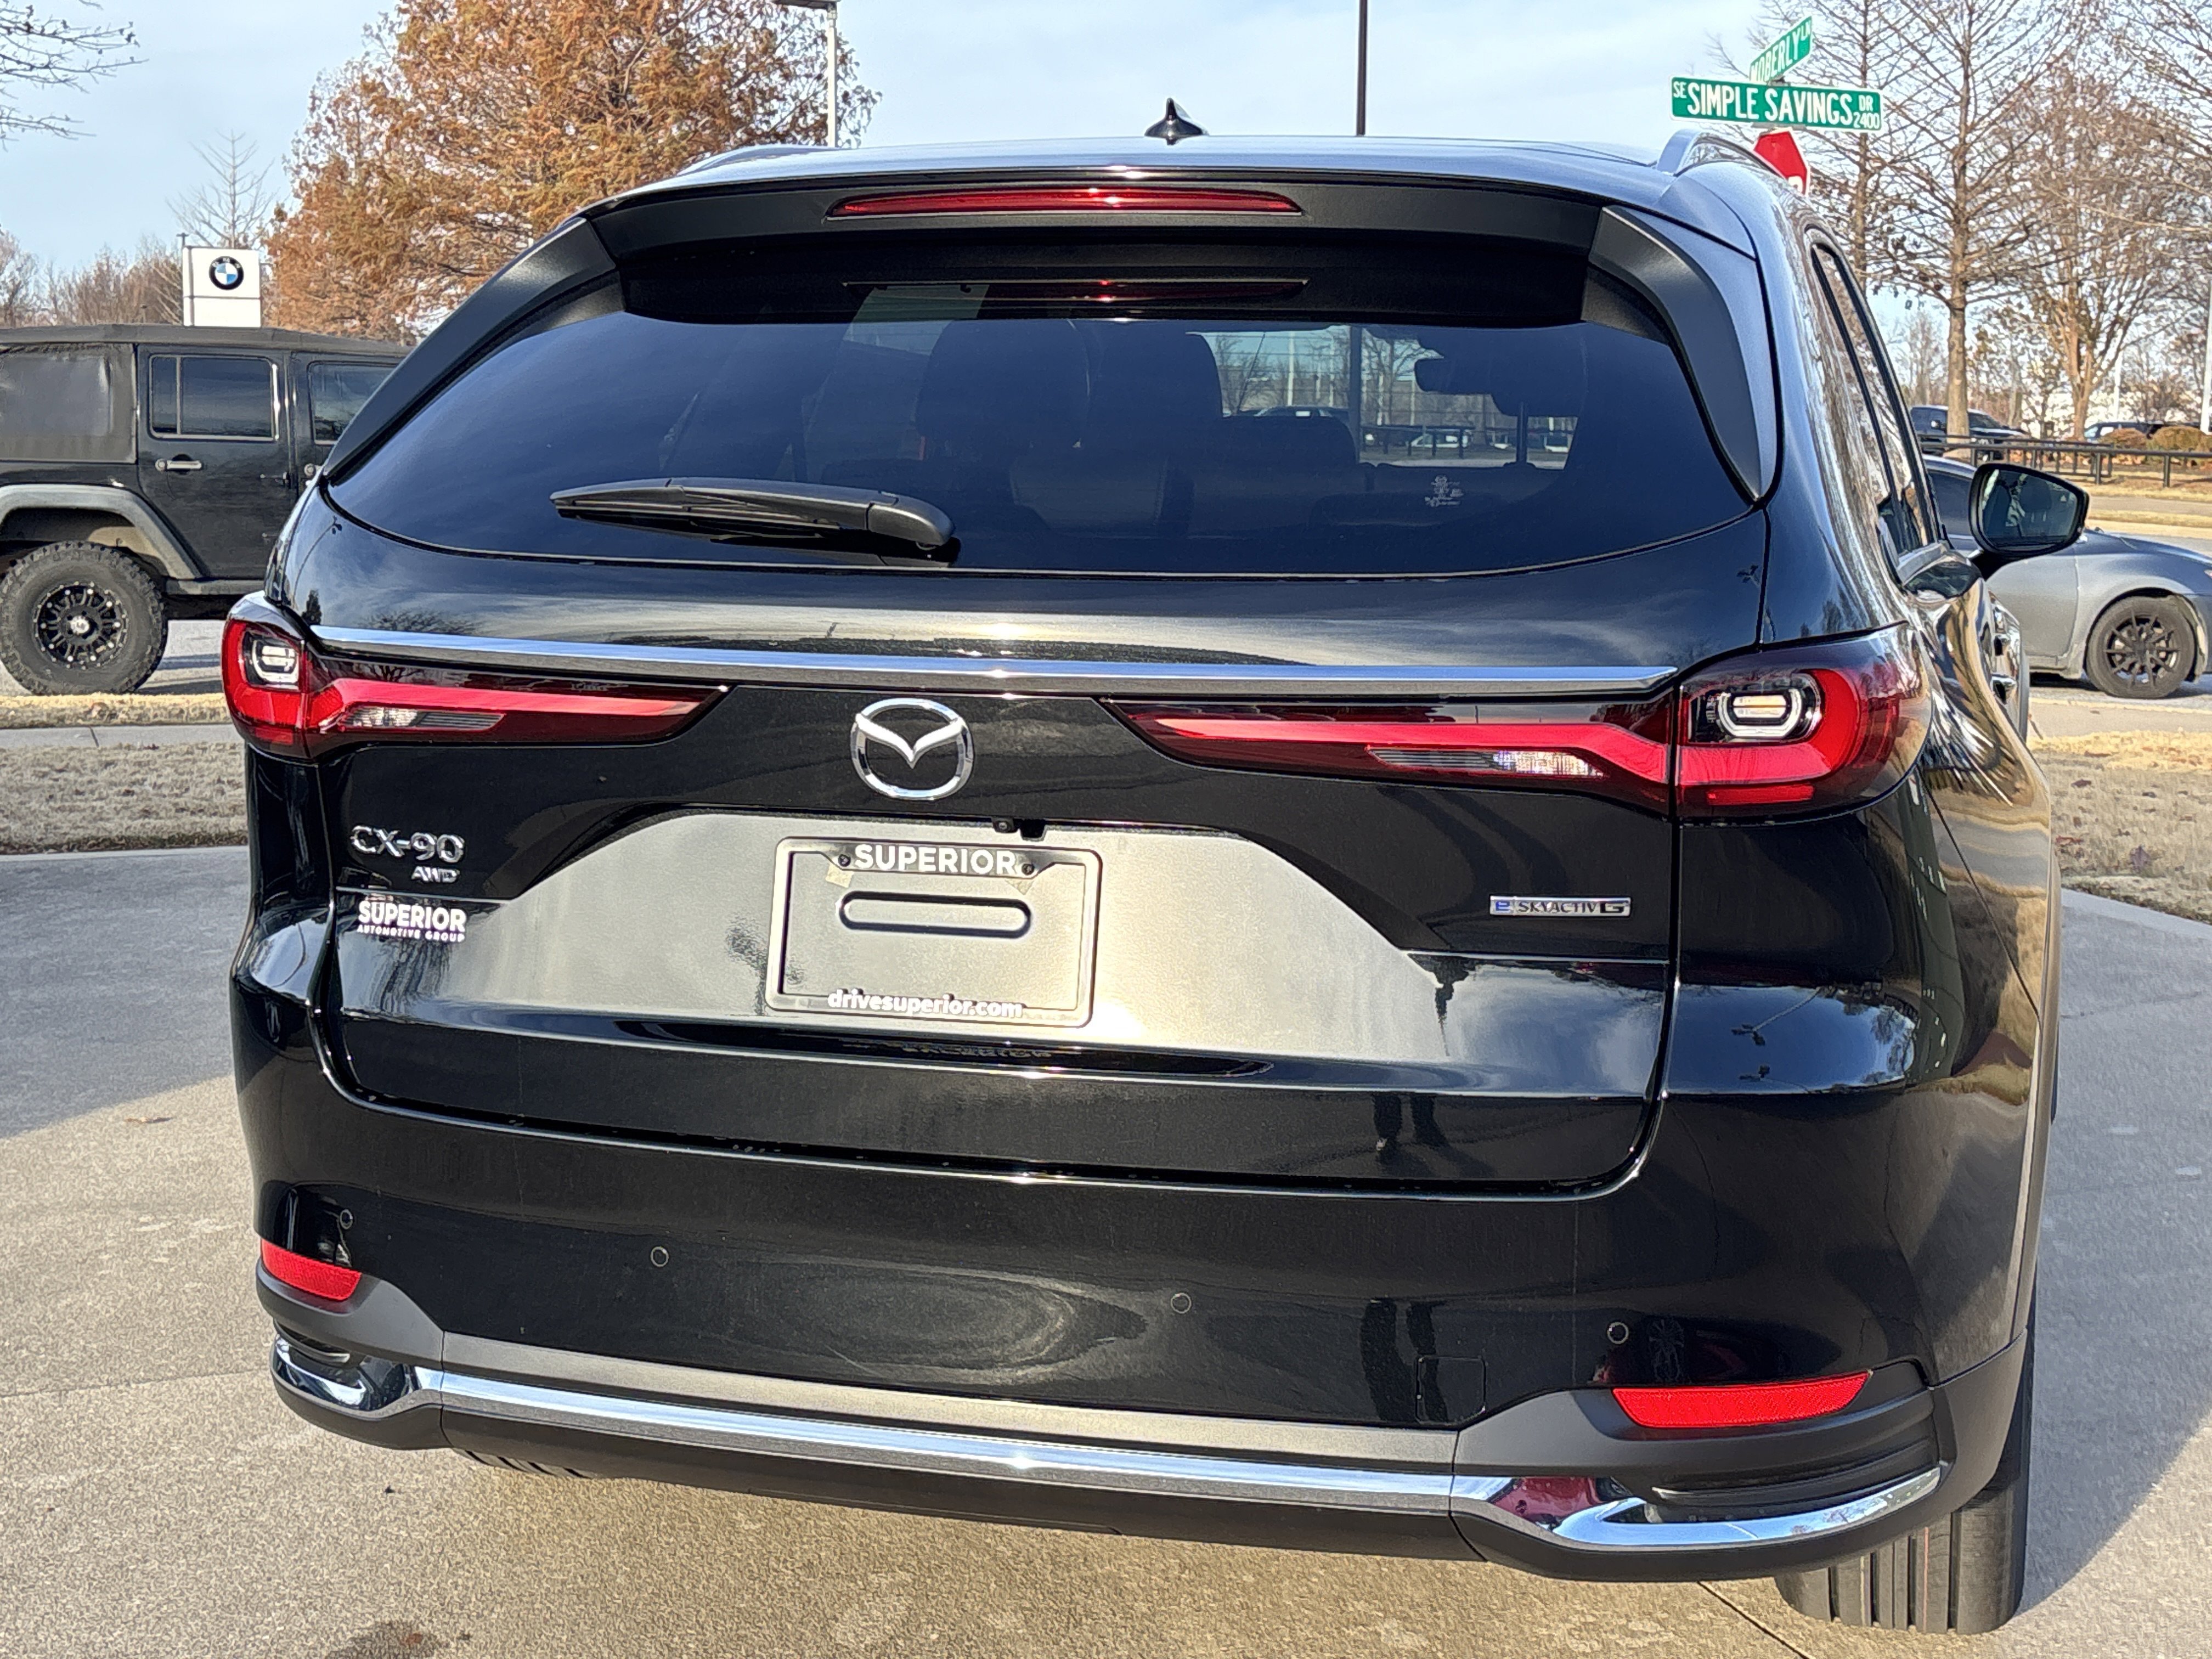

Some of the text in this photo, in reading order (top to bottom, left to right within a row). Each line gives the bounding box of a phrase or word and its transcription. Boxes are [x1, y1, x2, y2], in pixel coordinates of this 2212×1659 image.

[1751, 27, 1801, 82] MOBERLY
[1673, 81, 1874, 126] SE SIMPLE SAVINGS DR
[1853, 112, 1880, 129] 2400
[350, 825, 465, 864] CX-90
[855, 845, 1016, 874] SUPERIOR
[411, 866, 460, 883] AWD
[358, 901, 467, 932] SUPERIOR
[357, 924, 465, 943] AUTOMOTIVE GROUP
[827, 989, 1023, 1018] drivesuperior.com
